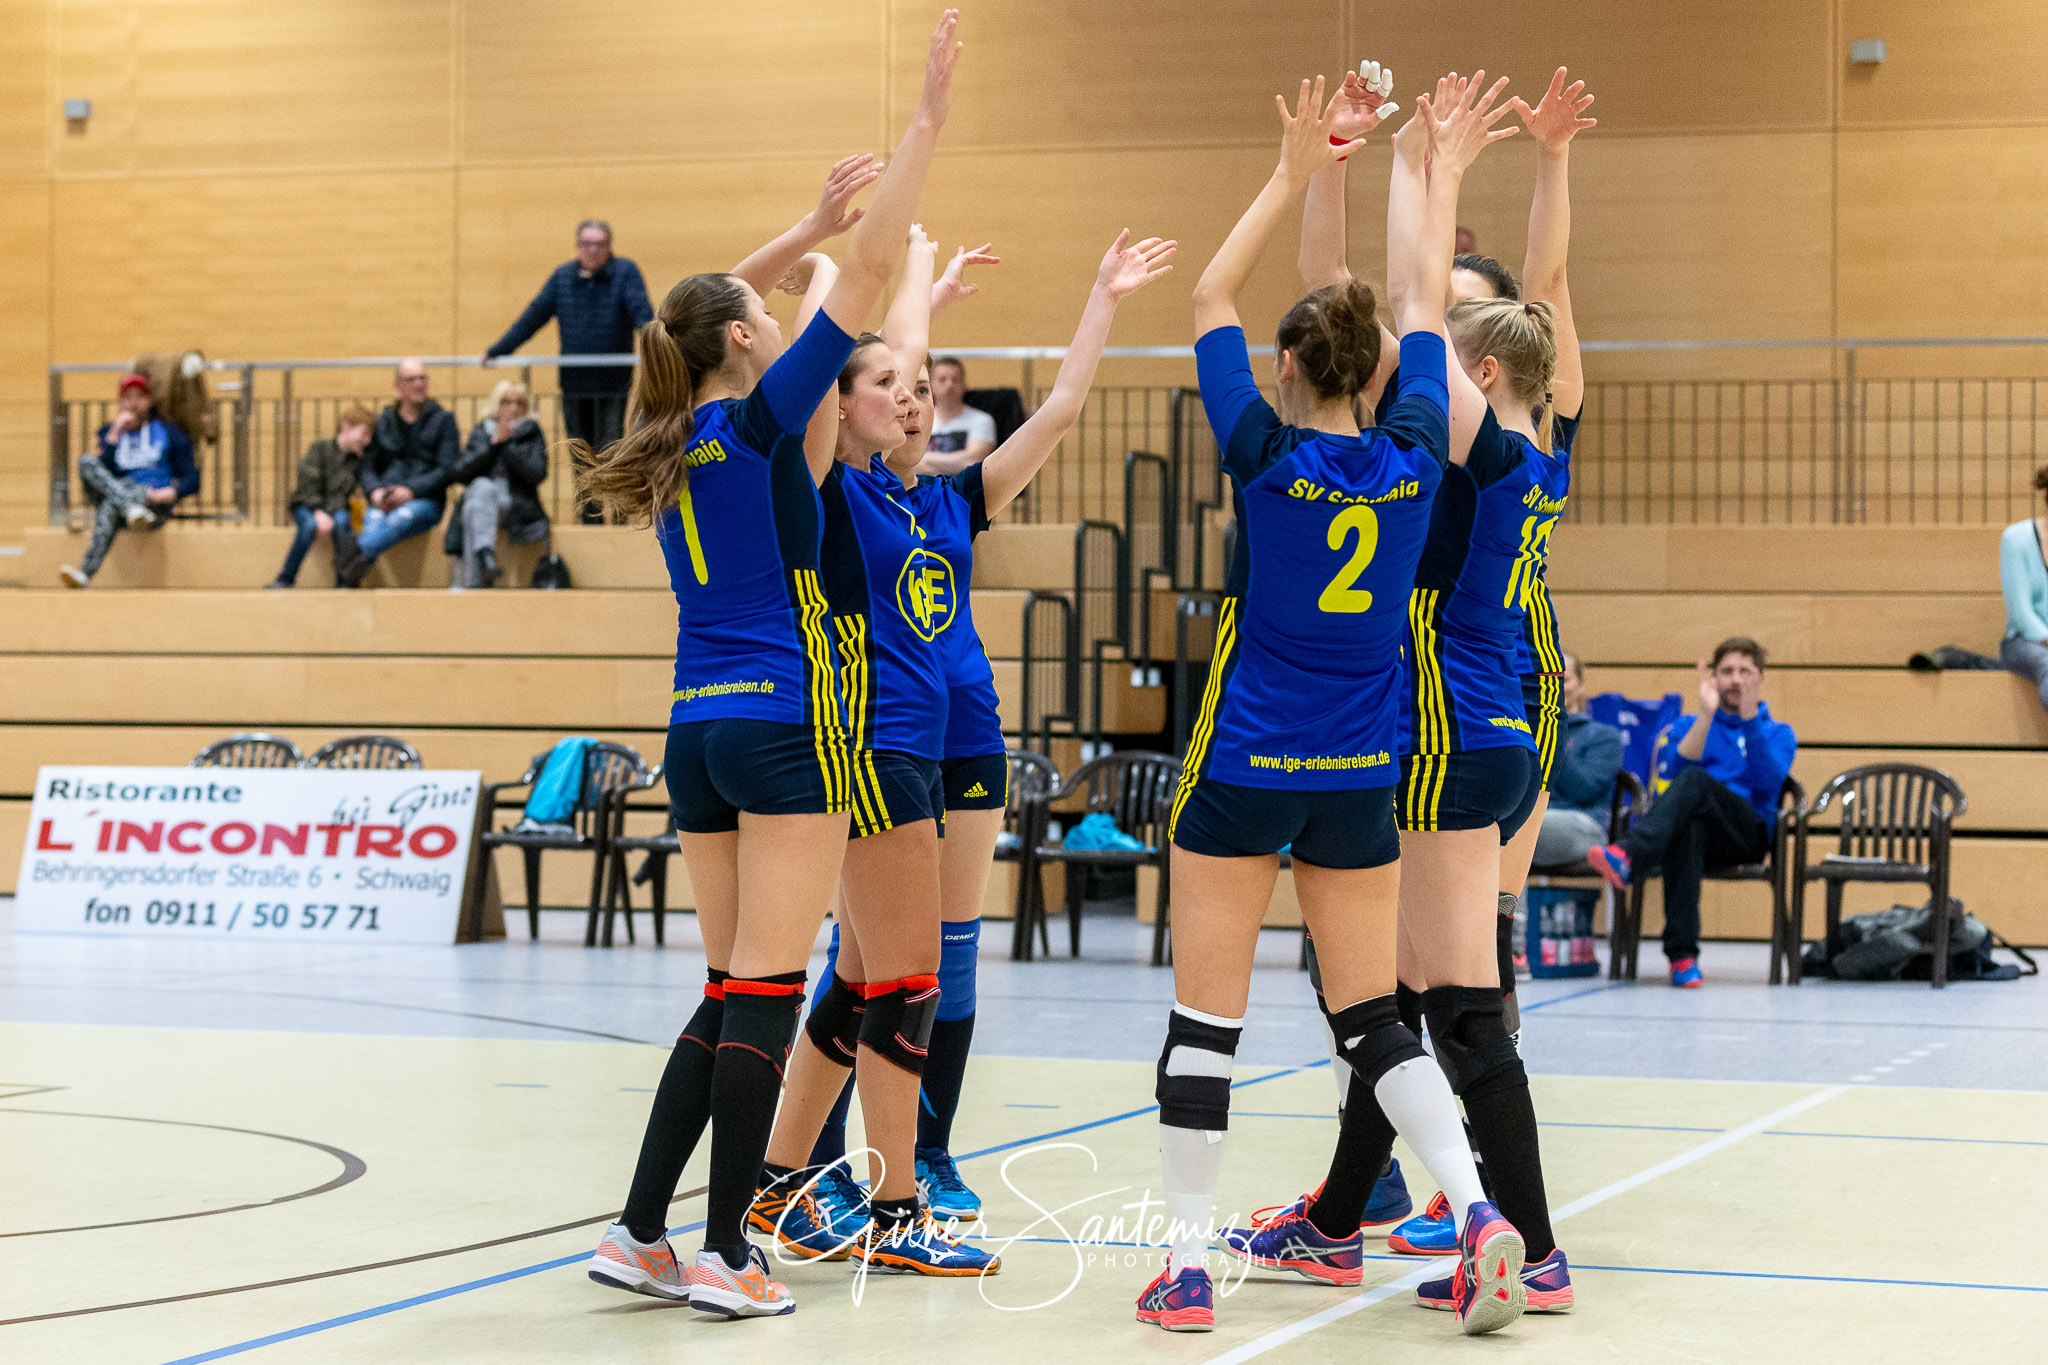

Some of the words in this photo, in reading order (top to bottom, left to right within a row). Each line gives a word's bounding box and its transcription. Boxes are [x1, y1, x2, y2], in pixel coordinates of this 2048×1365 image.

[685, 438, 727, 468] waig
[1288, 478, 1325, 501] SV
[1318, 504, 1379, 613] 2
[1250, 750, 1390, 773] www.ige-erlebnisreisen.de
[49, 779, 242, 803] Ristorante
[32, 861, 217, 889] Behringersdorfer
[226, 864, 298, 888] Straße
[307, 865, 323, 888] 6
[355, 865, 452, 897] Schwaig
[85, 899, 131, 924] fon
[145, 900, 217, 927] 0911
[251, 903, 290, 928] 50
[300, 904, 339, 929] 57
[348, 904, 381, 931] 71
[945, 932, 976, 941] DEMIX
